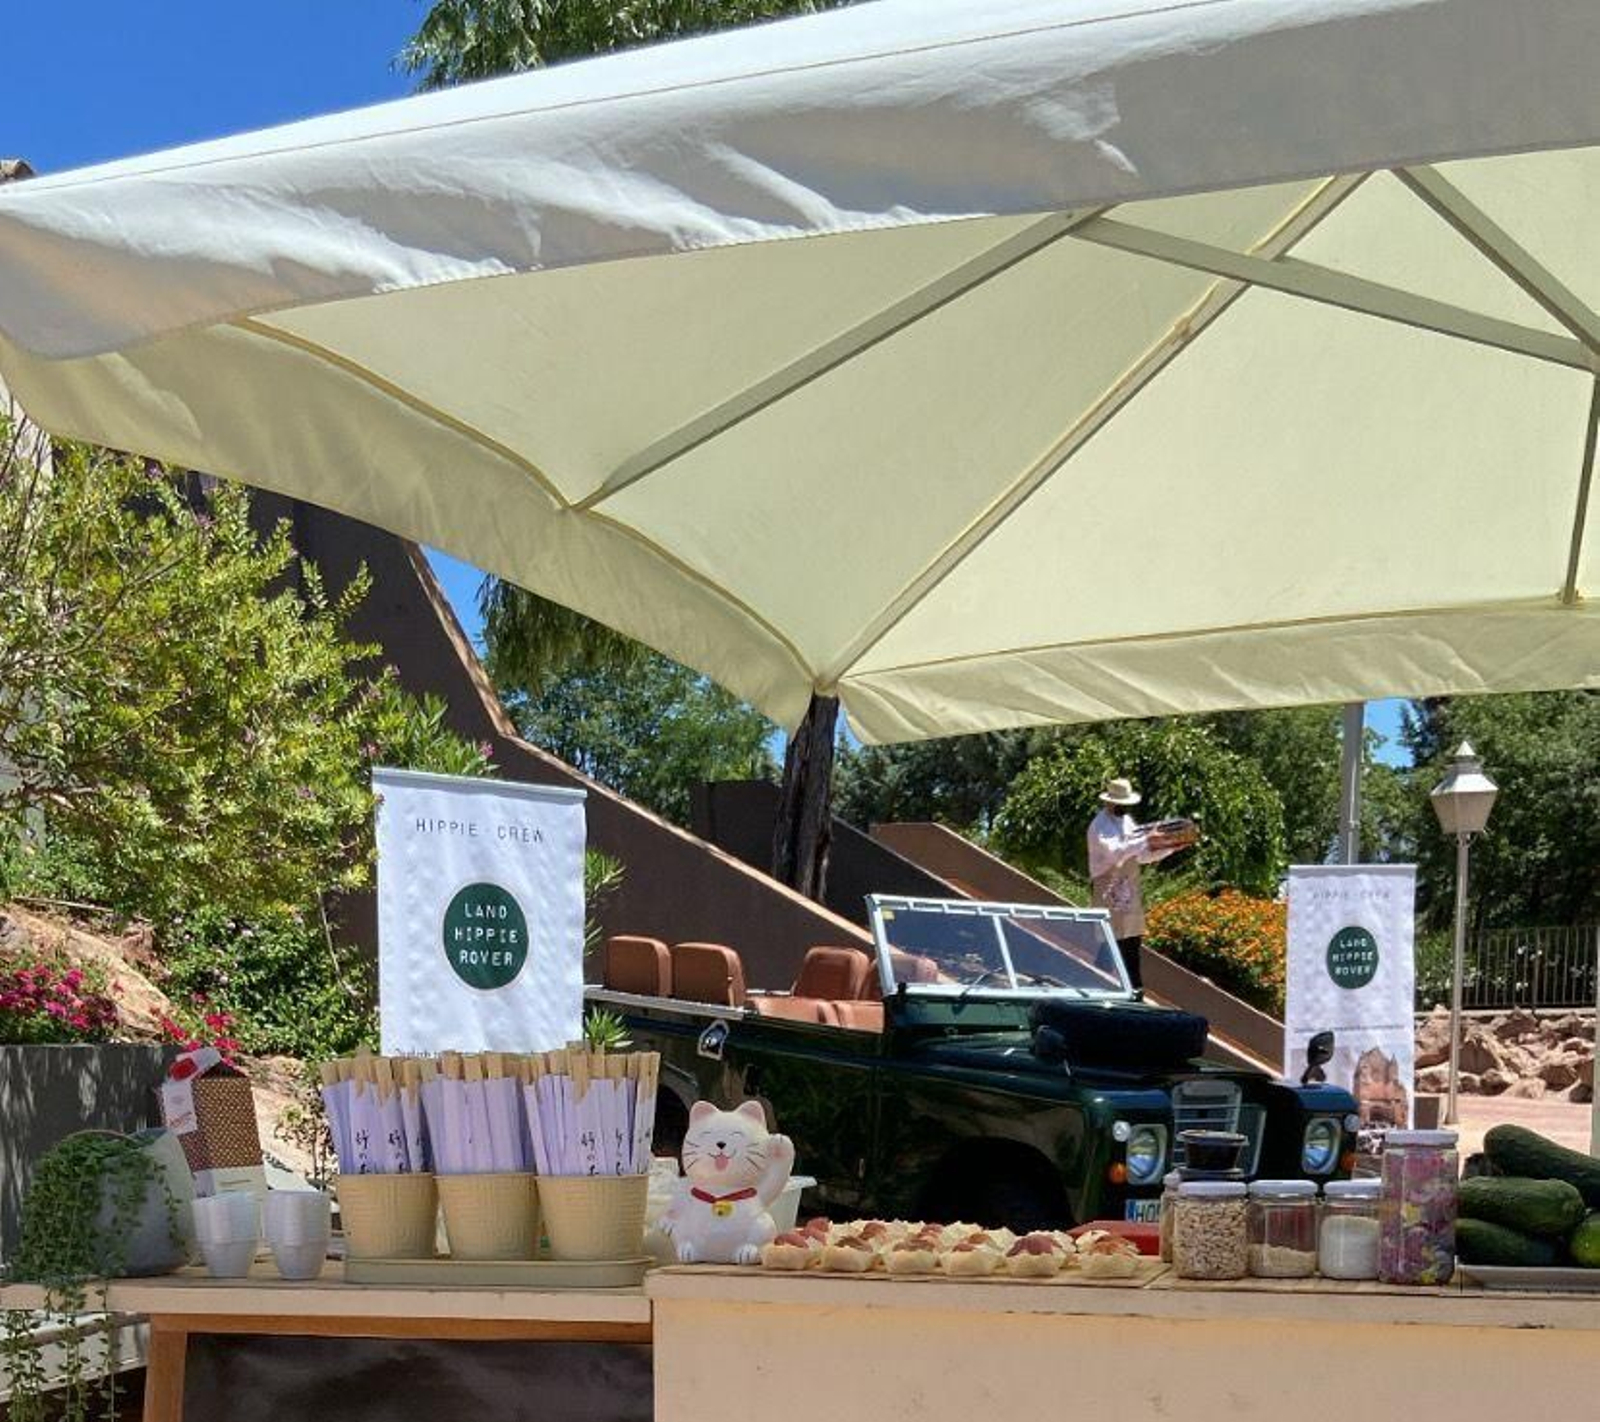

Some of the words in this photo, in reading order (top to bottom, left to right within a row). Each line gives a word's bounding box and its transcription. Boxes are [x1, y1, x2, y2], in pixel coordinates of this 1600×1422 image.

[415, 817, 479, 837] HIPPIE
[497, 825, 545, 844] CREW
[464, 903, 507, 919] LAND
[454, 926, 518, 944] HIPPIE
[459, 950, 513, 966] ROVER
[1332, 952, 1374, 962] HIPPIE
[1334, 966, 1371, 976] ROVER
[1134, 1202, 1161, 1223] HO
